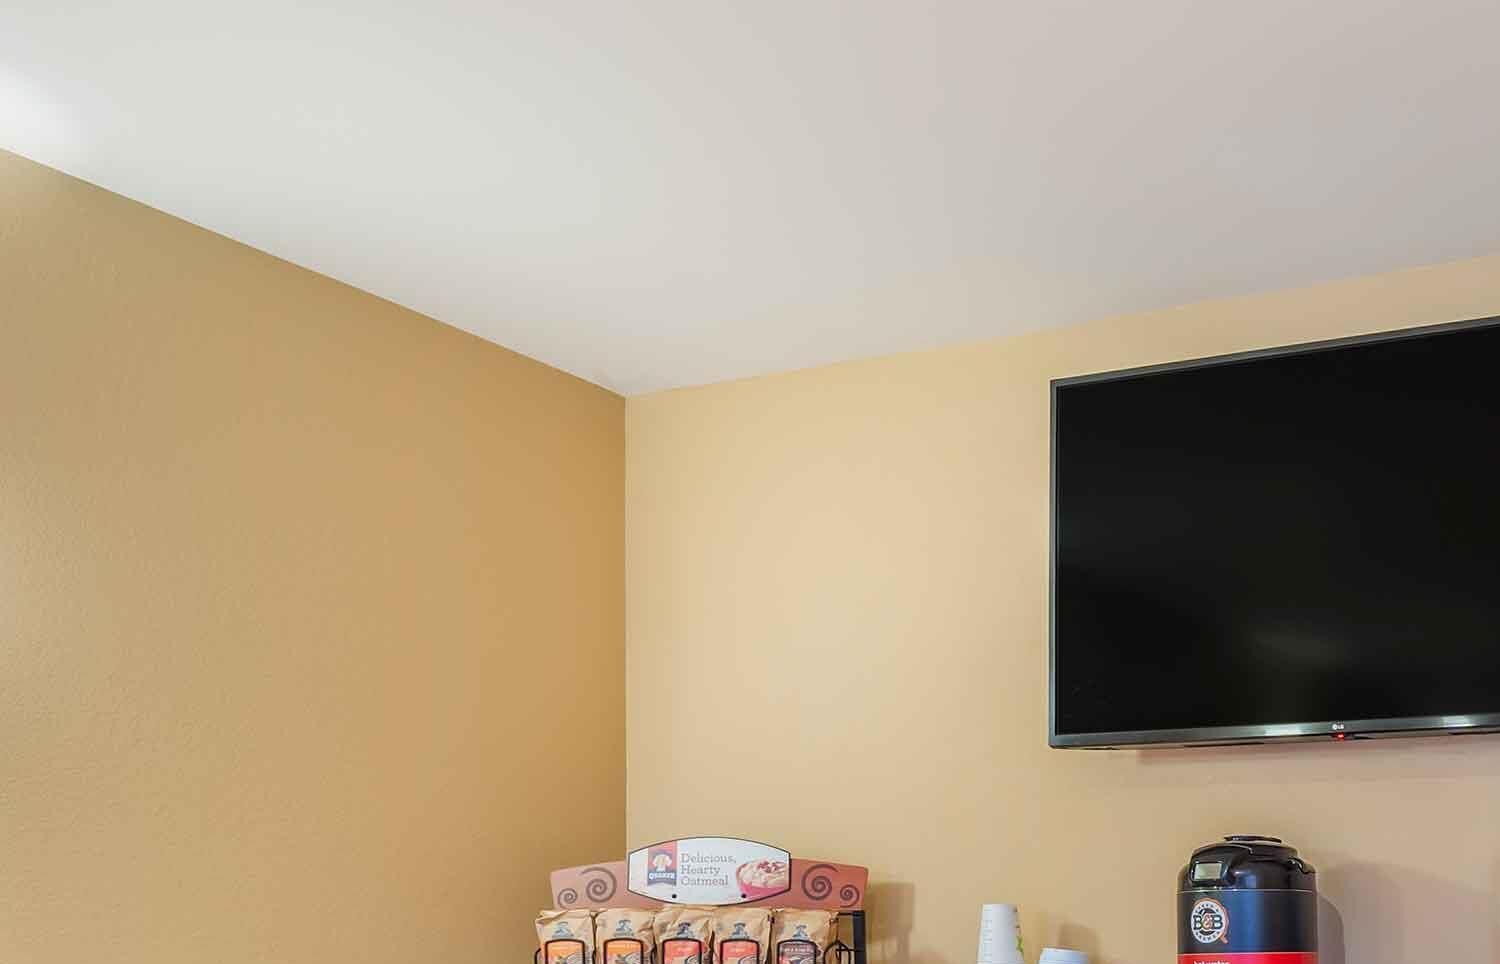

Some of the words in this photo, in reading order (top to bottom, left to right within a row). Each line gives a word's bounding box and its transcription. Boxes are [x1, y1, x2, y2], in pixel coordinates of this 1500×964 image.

[681, 852, 737, 864] Delicious,
[681, 864, 721, 877] Hearty
[681, 875, 729, 886] Oatmeal
